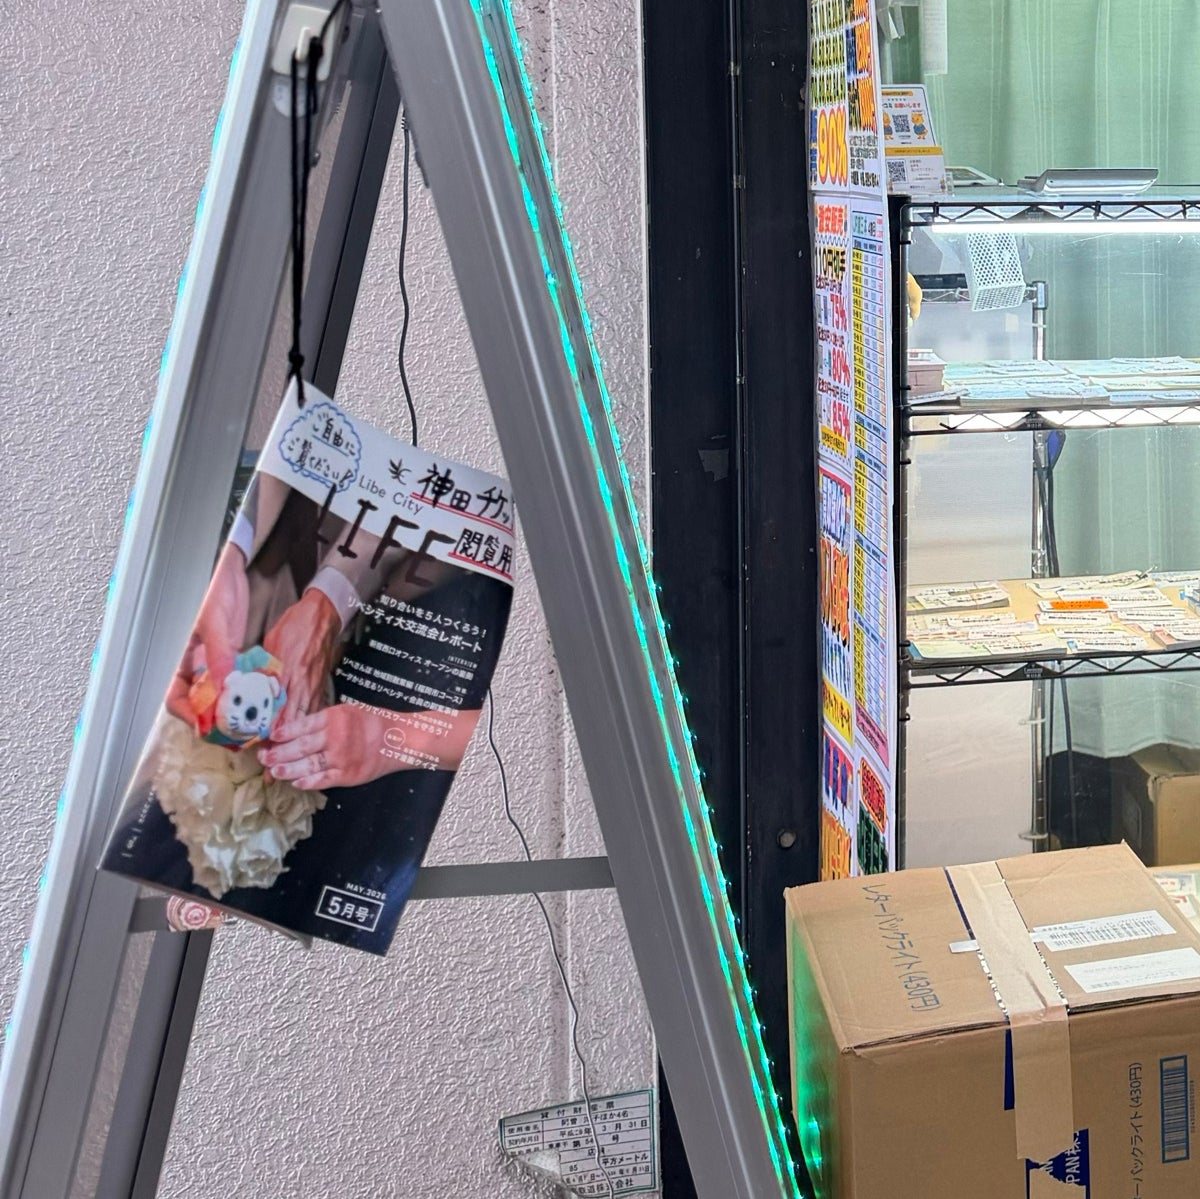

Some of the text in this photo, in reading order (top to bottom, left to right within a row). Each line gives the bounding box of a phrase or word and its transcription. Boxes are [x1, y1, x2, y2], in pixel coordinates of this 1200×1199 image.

[818, 106, 848, 187] 90%
[359, 475, 423, 515] Libe City
[315, 483, 457, 588] LIFE
[328, 896, 369, 922] 5月号
[602, 1154, 649, 1166] 平方メートル
[1128, 1062, 1144, 1199] ーパックライト(430円)
